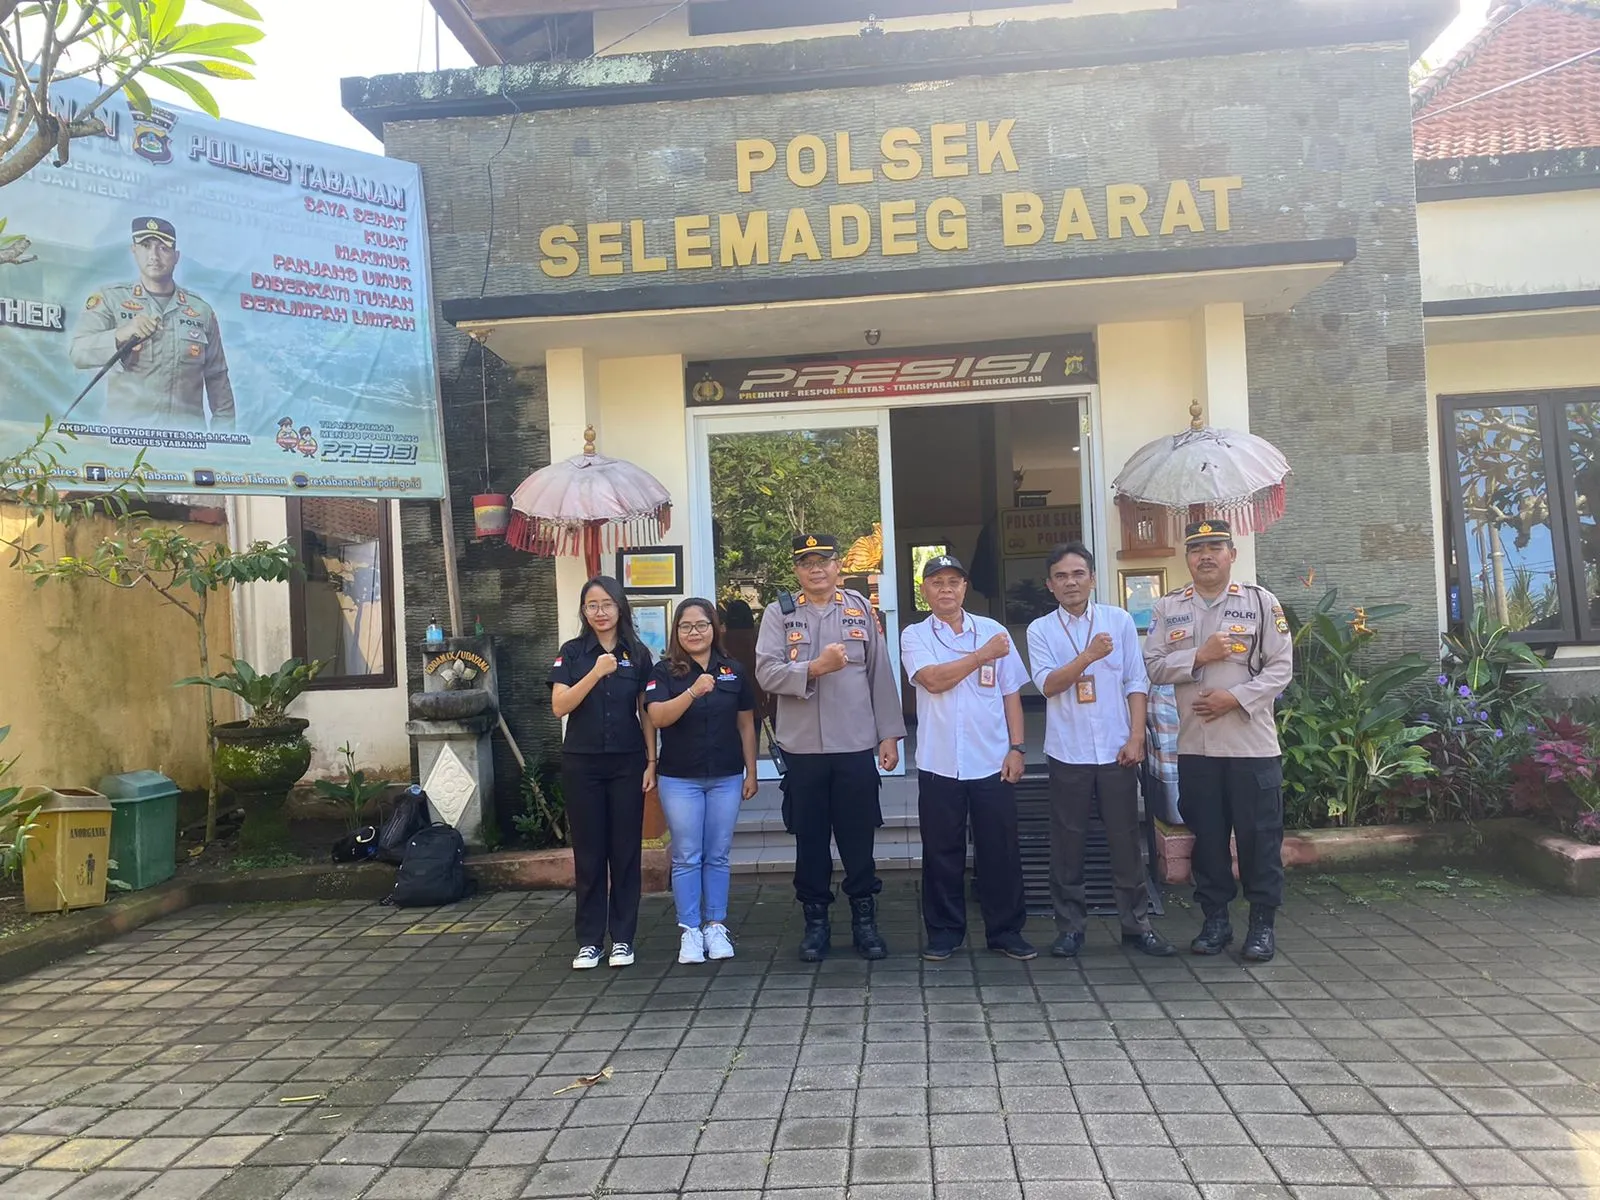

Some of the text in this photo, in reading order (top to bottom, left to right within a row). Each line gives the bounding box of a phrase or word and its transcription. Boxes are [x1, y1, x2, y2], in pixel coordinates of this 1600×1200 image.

[735, 118, 1019, 193] POLSEK
[188, 135, 293, 183] POLRES
[296, 161, 408, 210] TABANAN
[304, 196, 349, 219] SAYA
[353, 207, 408, 231] SEHAT
[538, 175, 1243, 278] SELEMADEG BARAT
[364, 229, 408, 250] KUAT
[335, 244, 411, 271] MAKMUR
[273, 254, 413, 292] PANJANG UMUR
[251, 272, 414, 312] DIBERKATI TUHAN
[240, 293, 416, 332] BERLIMPAH LIMPAH
[740, 351, 1052, 391] PRESISI
[797, 386, 886, 397] RESPONSIBILITAS
[893, 380, 971, 392] TRANSPARANSI
[972, 375, 1043, 387] BERKEADILAN
[319, 421, 394, 433] TRANSFORMASI
[320, 430, 361, 440] MENUJU
[362, 432, 391, 442] POLRI
[111, 437, 206, 449] KAPOLRES TABANAN
[320, 440, 418, 460] PRESISI
[215, 472, 287, 486] Polres Tabanan
[842, 618, 867, 627] POLRI
[1224, 610, 1256, 620] POLRI
